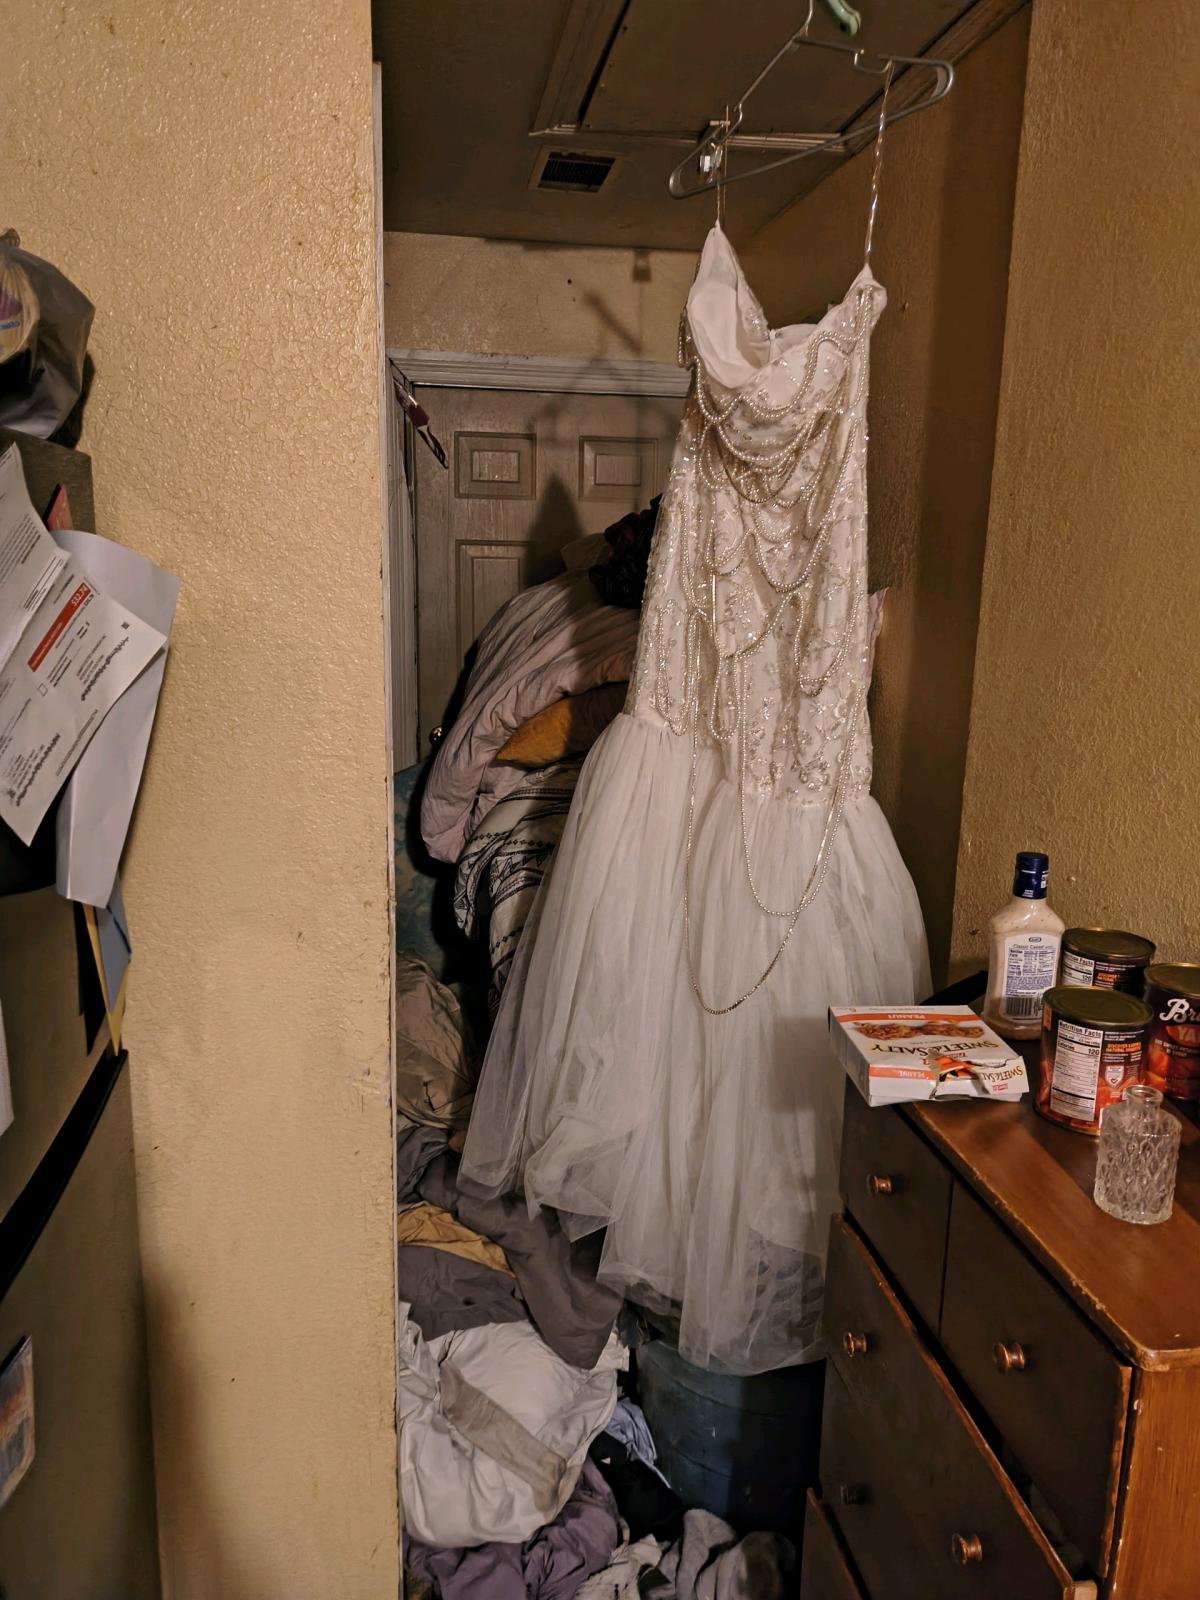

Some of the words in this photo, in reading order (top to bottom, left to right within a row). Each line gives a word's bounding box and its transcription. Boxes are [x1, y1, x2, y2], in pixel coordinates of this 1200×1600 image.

[1060, 1021, 1083, 1034] Nutrition
[1084, 1028, 1102, 1038] Facts
[1177, 1025, 1200, 1042] YA
[871, 1044, 927, 1056] SALTY
[1088, 1048, 1100, 1056] 120
